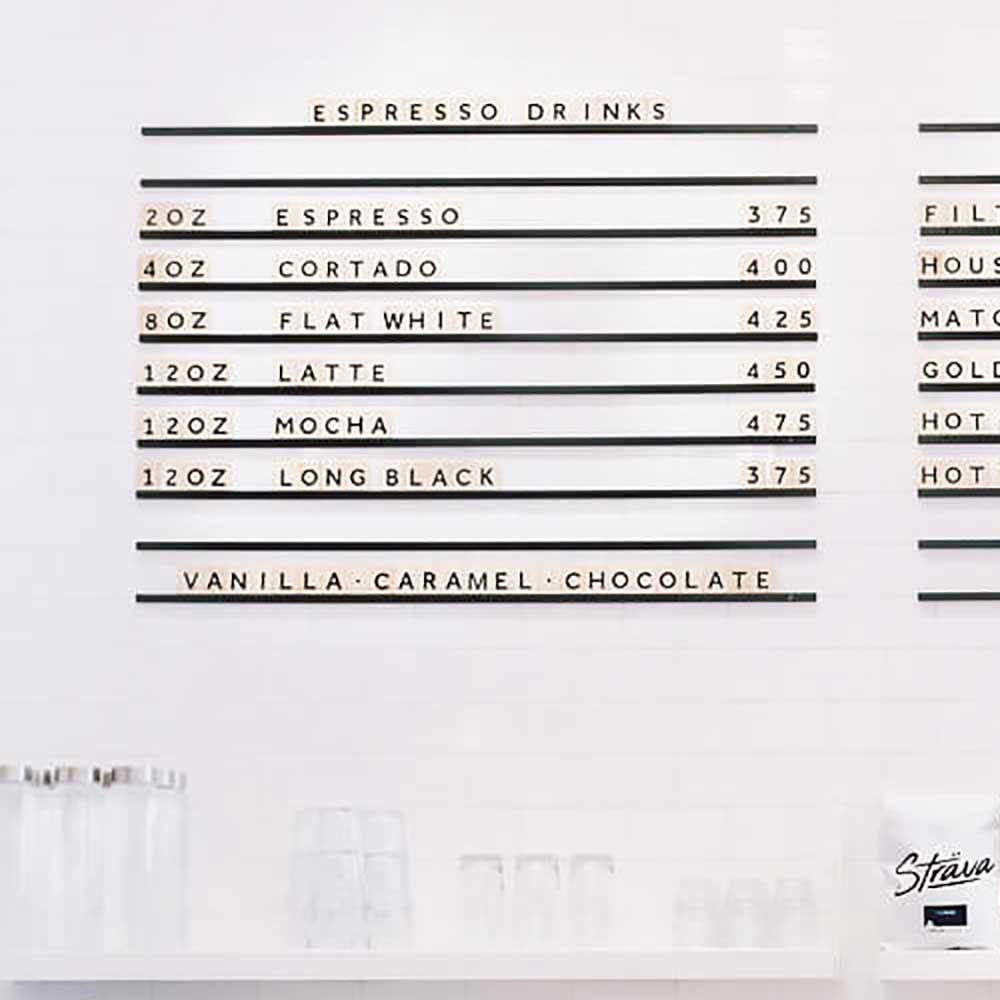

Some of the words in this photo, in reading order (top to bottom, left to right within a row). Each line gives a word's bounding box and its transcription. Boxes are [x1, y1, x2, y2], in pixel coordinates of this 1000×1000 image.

[313, 103, 498, 123] ESPRESSO
[527, 102, 665, 121] DRINKS
[146, 208, 206, 227] 2OZ
[276, 207, 459, 227] ESPRESSO
[749, 205, 811, 224] 375
[143, 260, 205, 278] 4OZ
[279, 259, 437, 278] CORTADO
[746, 257, 812, 276] 400
[145, 311, 207, 331] 8OZ
[280, 312, 364, 330] FLAT
[383, 311, 493, 330] WHITE
[747, 310, 812, 329] 425
[145, 363, 228, 382] 12OZ
[279, 363, 384, 383] LATTE
[747, 361, 810, 379] 450
[143, 416, 228, 436] 12OZ
[275, 416, 387, 435] MOCHA
[747, 413, 811, 432] 475
[922, 412, 985, 431] HOT
[143, 468, 226, 487] 12OZ
[280, 468, 366, 487] LONG
[385, 468, 493, 487] BLACK
[747, 466, 811, 485] 375
[921, 465, 985, 485] HOT
[183, 571, 342, 591] VANILLA
[374, 571, 532, 591] CARAMEL
[565, 571, 769, 590] CHOCOLATE
